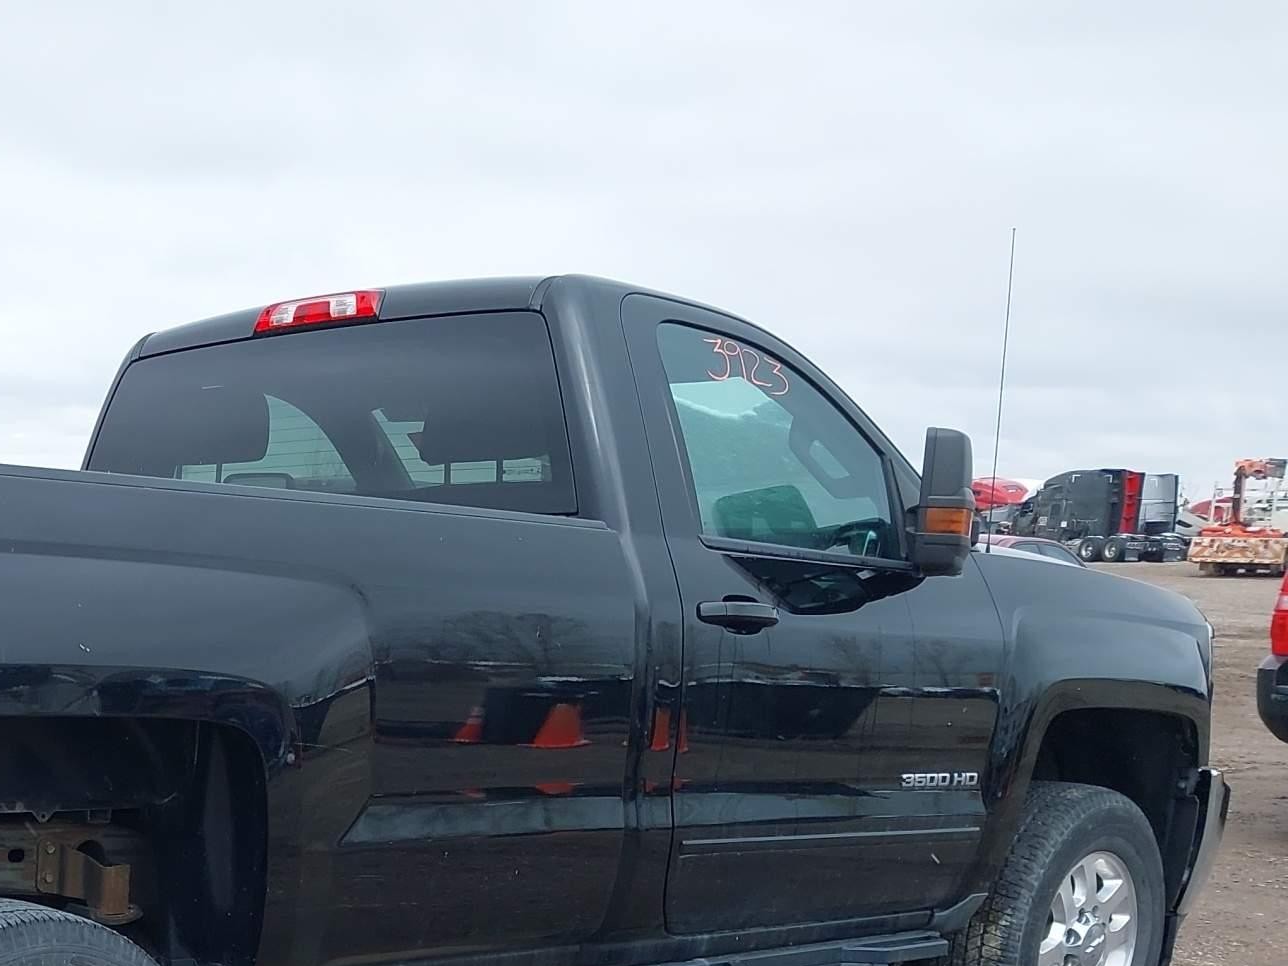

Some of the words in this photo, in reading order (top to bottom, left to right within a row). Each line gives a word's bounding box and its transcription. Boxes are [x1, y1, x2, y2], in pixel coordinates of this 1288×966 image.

[703, 337, 789, 395] 3923
[900, 773, 951, 787] 3500
[953, 772, 979, 786] HD
